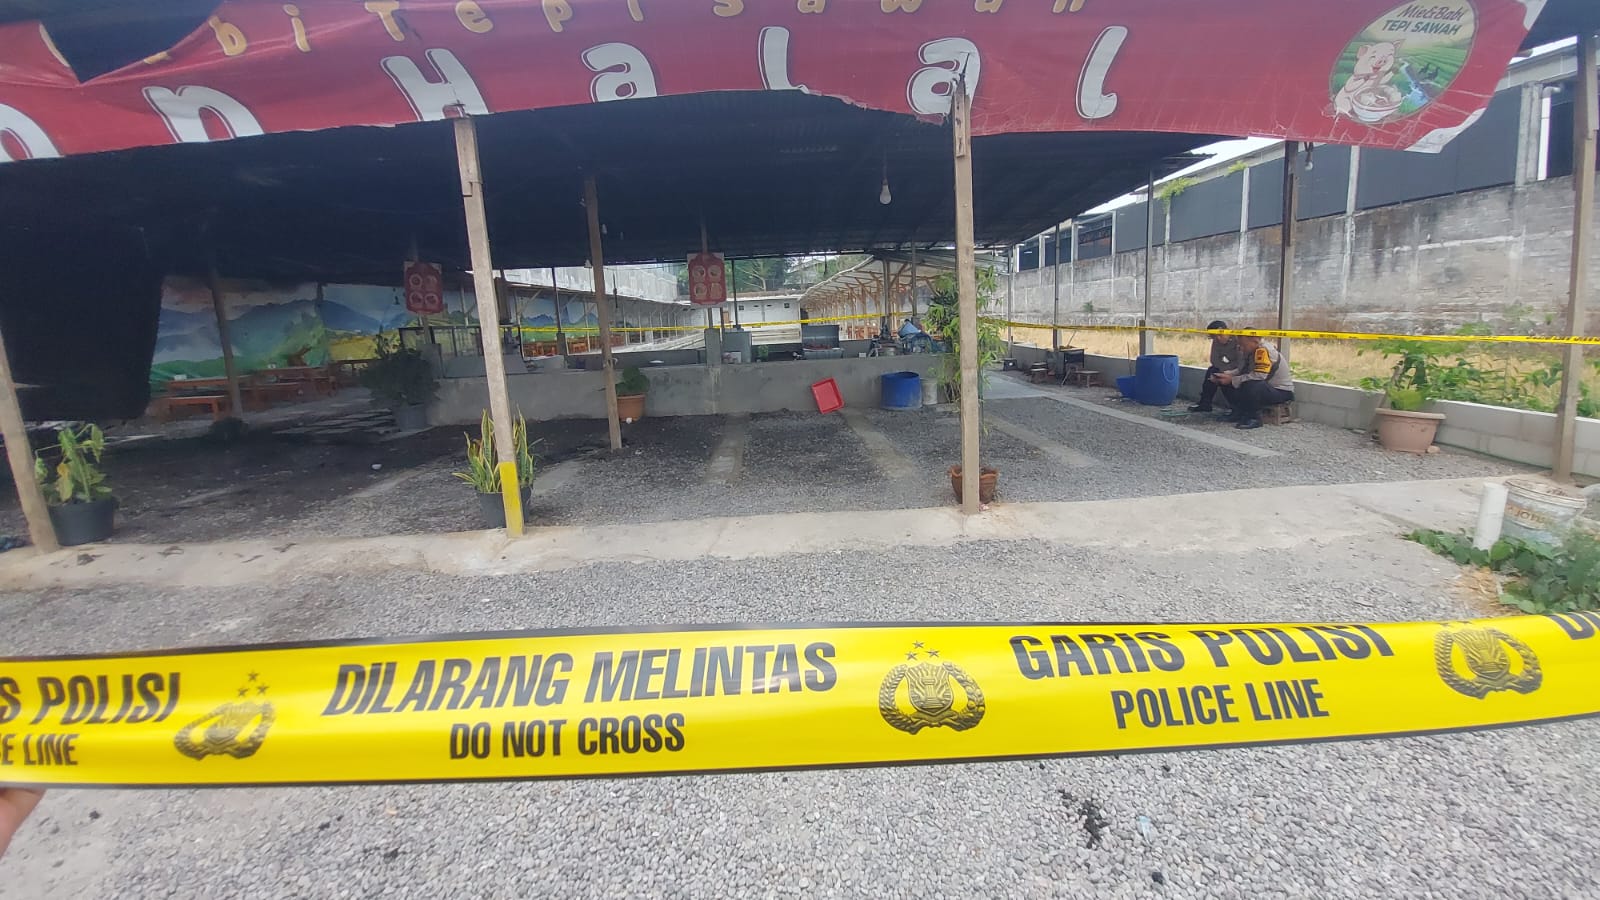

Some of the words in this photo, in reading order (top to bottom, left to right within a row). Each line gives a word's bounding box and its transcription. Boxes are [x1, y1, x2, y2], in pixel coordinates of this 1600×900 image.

[1382, 20, 1412, 32] TEPI
[1411, 22, 1462, 35] SAWAH
[1008, 631, 1186, 680] GARIS
[1187, 624, 1395, 667] POLISI
[29, 672, 181, 725] POLISI
[321, 653, 574, 716] DILARANG
[585, 641, 838, 702] MELINTAS
[1110, 681, 1238, 729] POLICE
[1243, 678, 1330, 721] LINE
[23, 733, 80, 765] LINE
[450, 722, 491, 760] DO
[502, 719, 567, 757] NOT
[577, 712, 686, 756] CROSS
